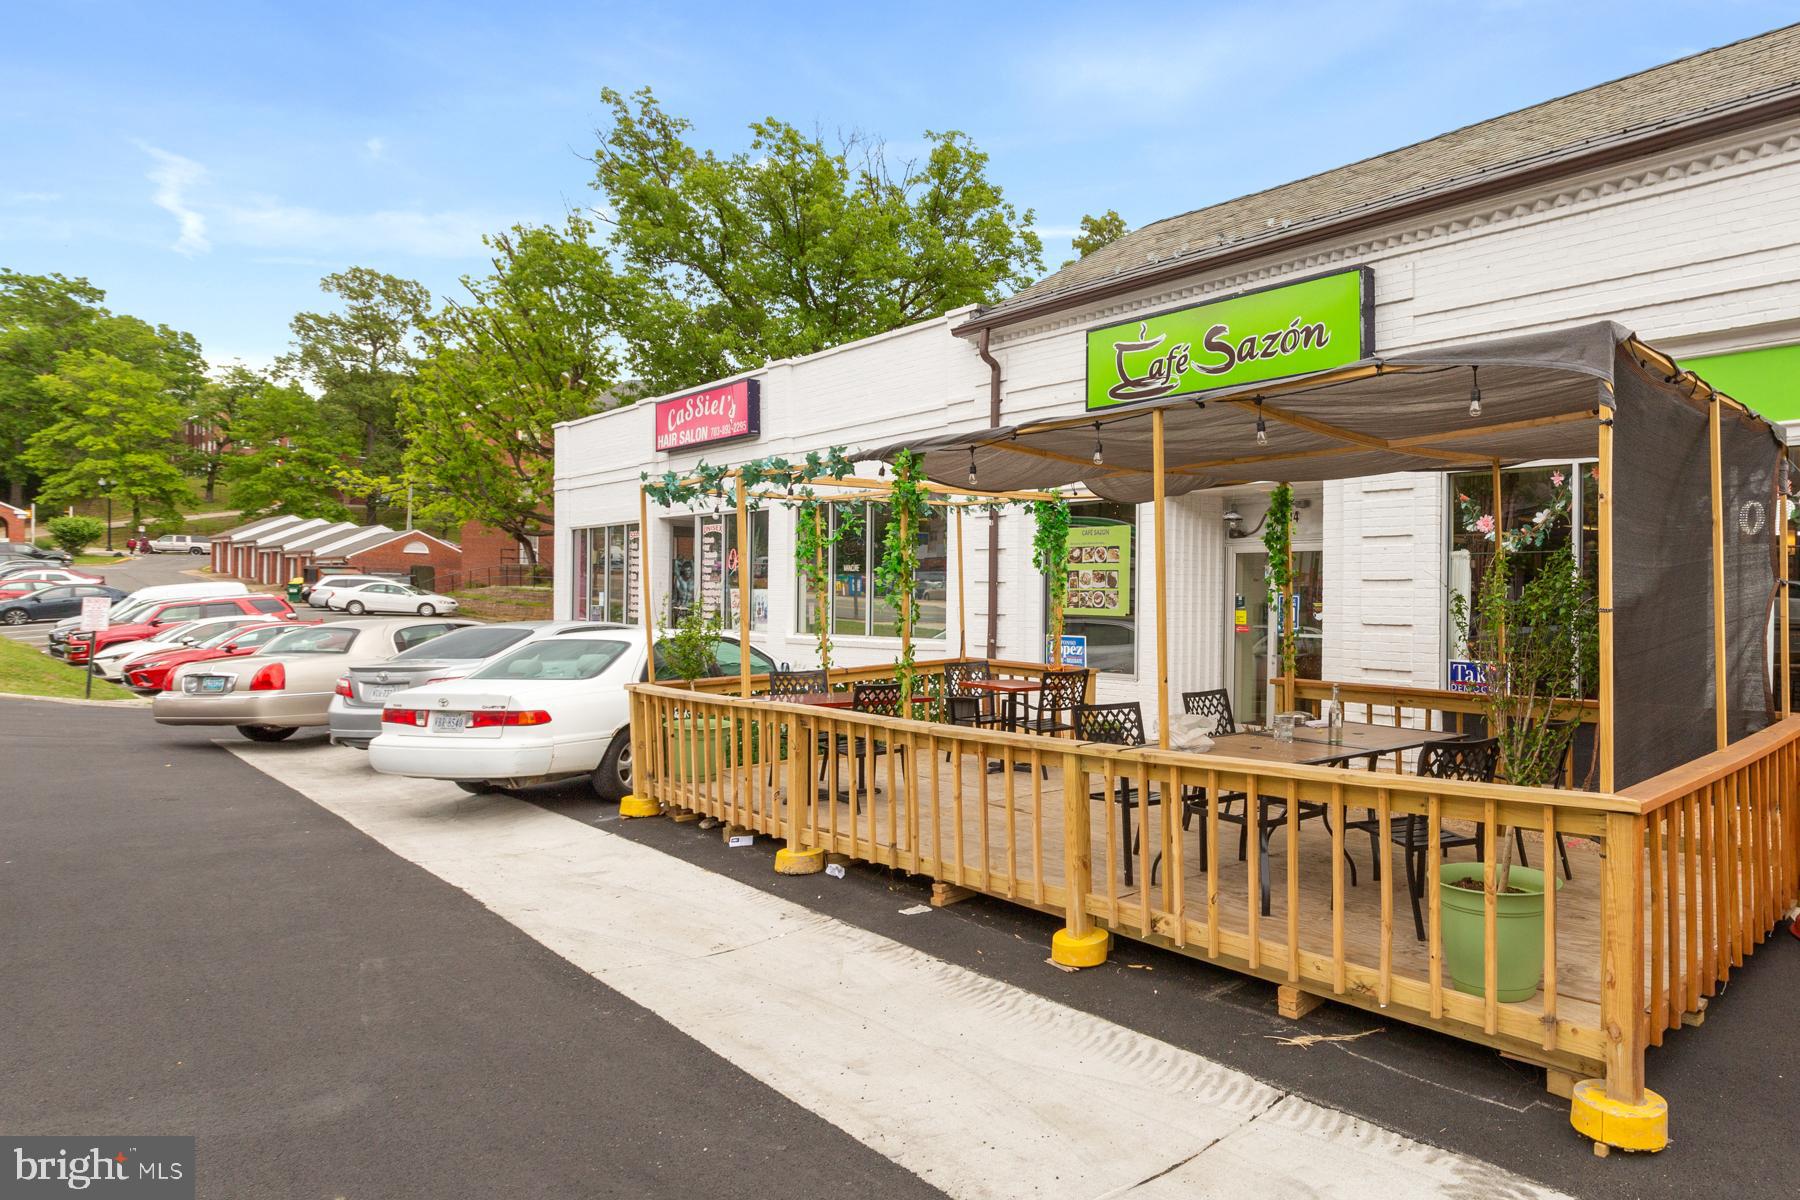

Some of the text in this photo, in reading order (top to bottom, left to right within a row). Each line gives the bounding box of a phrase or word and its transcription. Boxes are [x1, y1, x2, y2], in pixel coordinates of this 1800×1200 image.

[1108, 316, 1332, 401] Café Sazón
[657, 432, 678, 449] HAIR
[679, 426, 708, 444] SALON
[1050, 640, 1083, 658] Lpez
[1453, 664, 1490, 684] Tak
